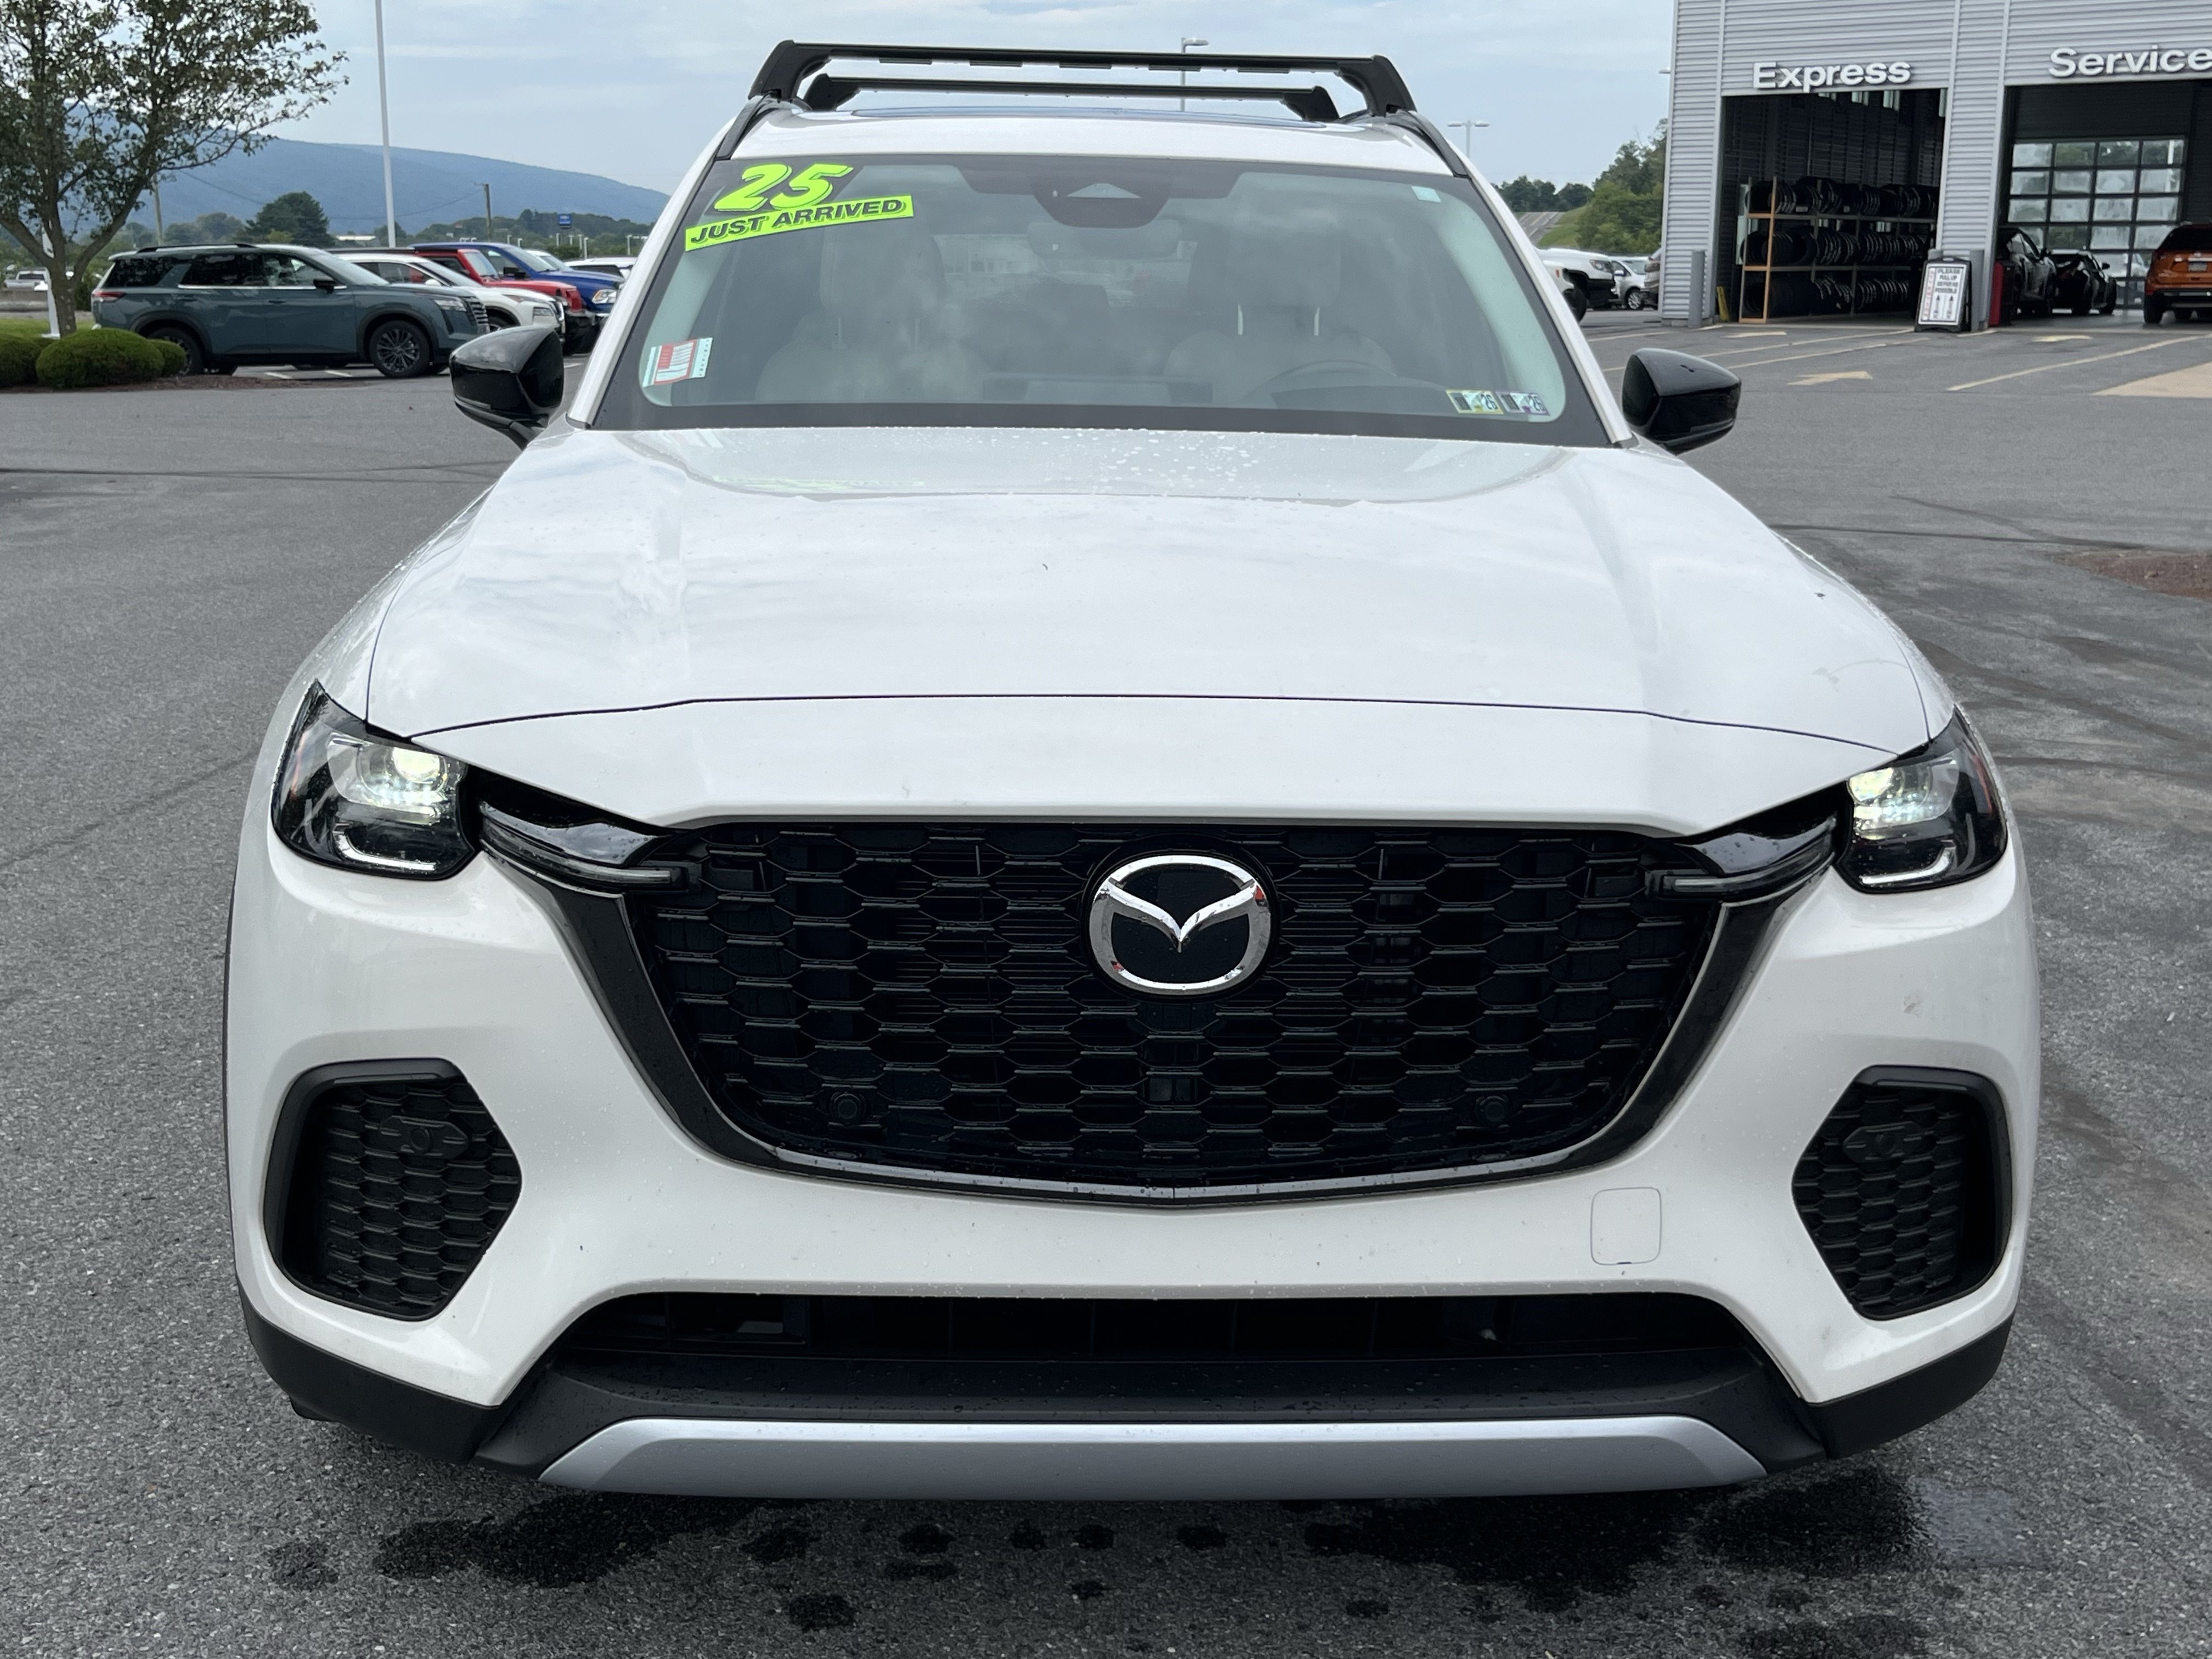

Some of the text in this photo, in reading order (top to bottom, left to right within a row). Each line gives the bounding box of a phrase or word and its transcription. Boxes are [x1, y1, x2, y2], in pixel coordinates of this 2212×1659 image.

[1753, 61, 1911, 93] Express
[2049, 44, 2212, 77] Service
[714, 163, 854, 211] 25
[690, 200, 906, 245] JUST ARRIVED
